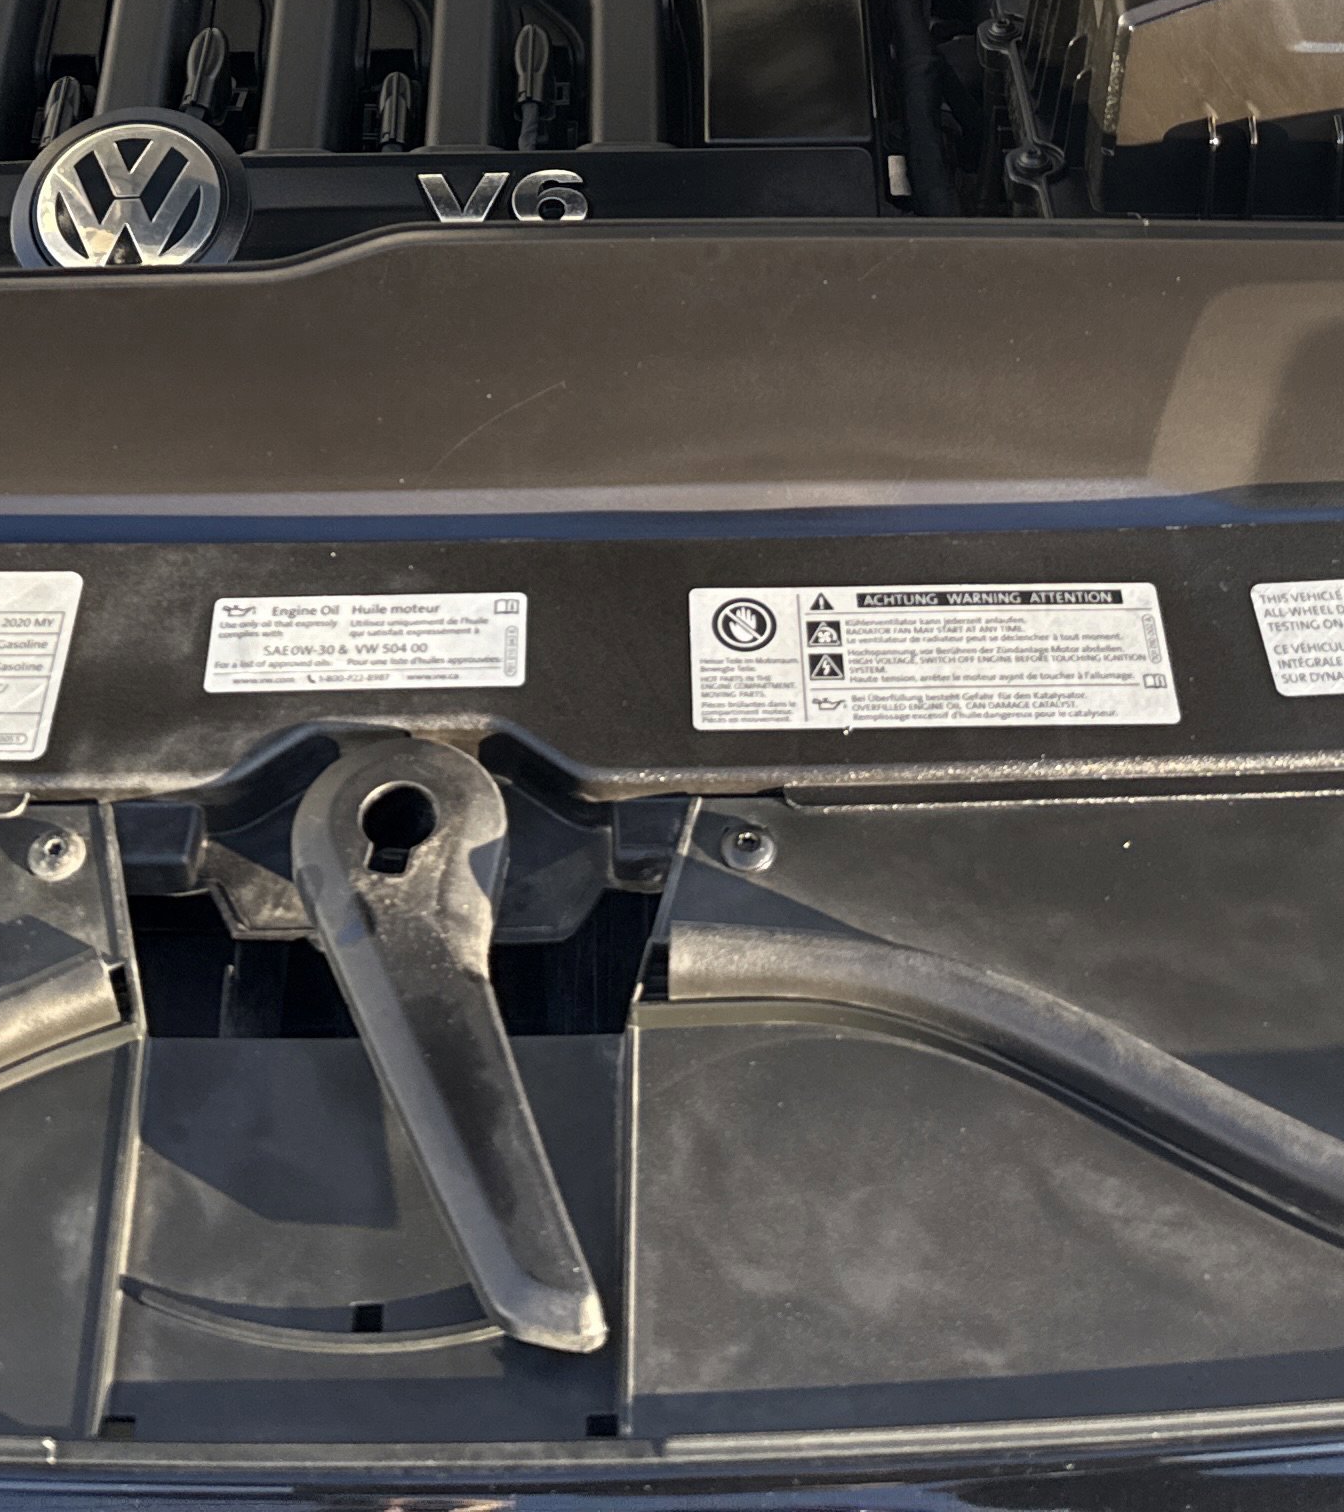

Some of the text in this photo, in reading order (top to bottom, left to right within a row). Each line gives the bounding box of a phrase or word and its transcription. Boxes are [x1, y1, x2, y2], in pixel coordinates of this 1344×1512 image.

[417, 169, 588, 222] V6
[864, 591, 1113, 606] ACHTUNG WARNING ATTENTION
[1260, 593, 1288, 604] THIS
[1290, 591, 1342, 602] VEHICLE
[272, 604, 340, 618] Engine Oil
[352, 604, 440, 615] Huile moteur
[1264, 604, 1334, 618] ALL-WHEEL
[2, 618, 55, 628] 2020 MY
[1267, 620, 1320, 632] TESTING
[1323, 618, 1344, 629] ON
[338, 644, 348, 655] &
[356, 644, 380, 654] VW
[382, 643, 407, 654] 504
[410, 642, 428, 653] 00
[1273, 644, 1289, 655] CE
[1281, 672, 1307, 684] SUR
